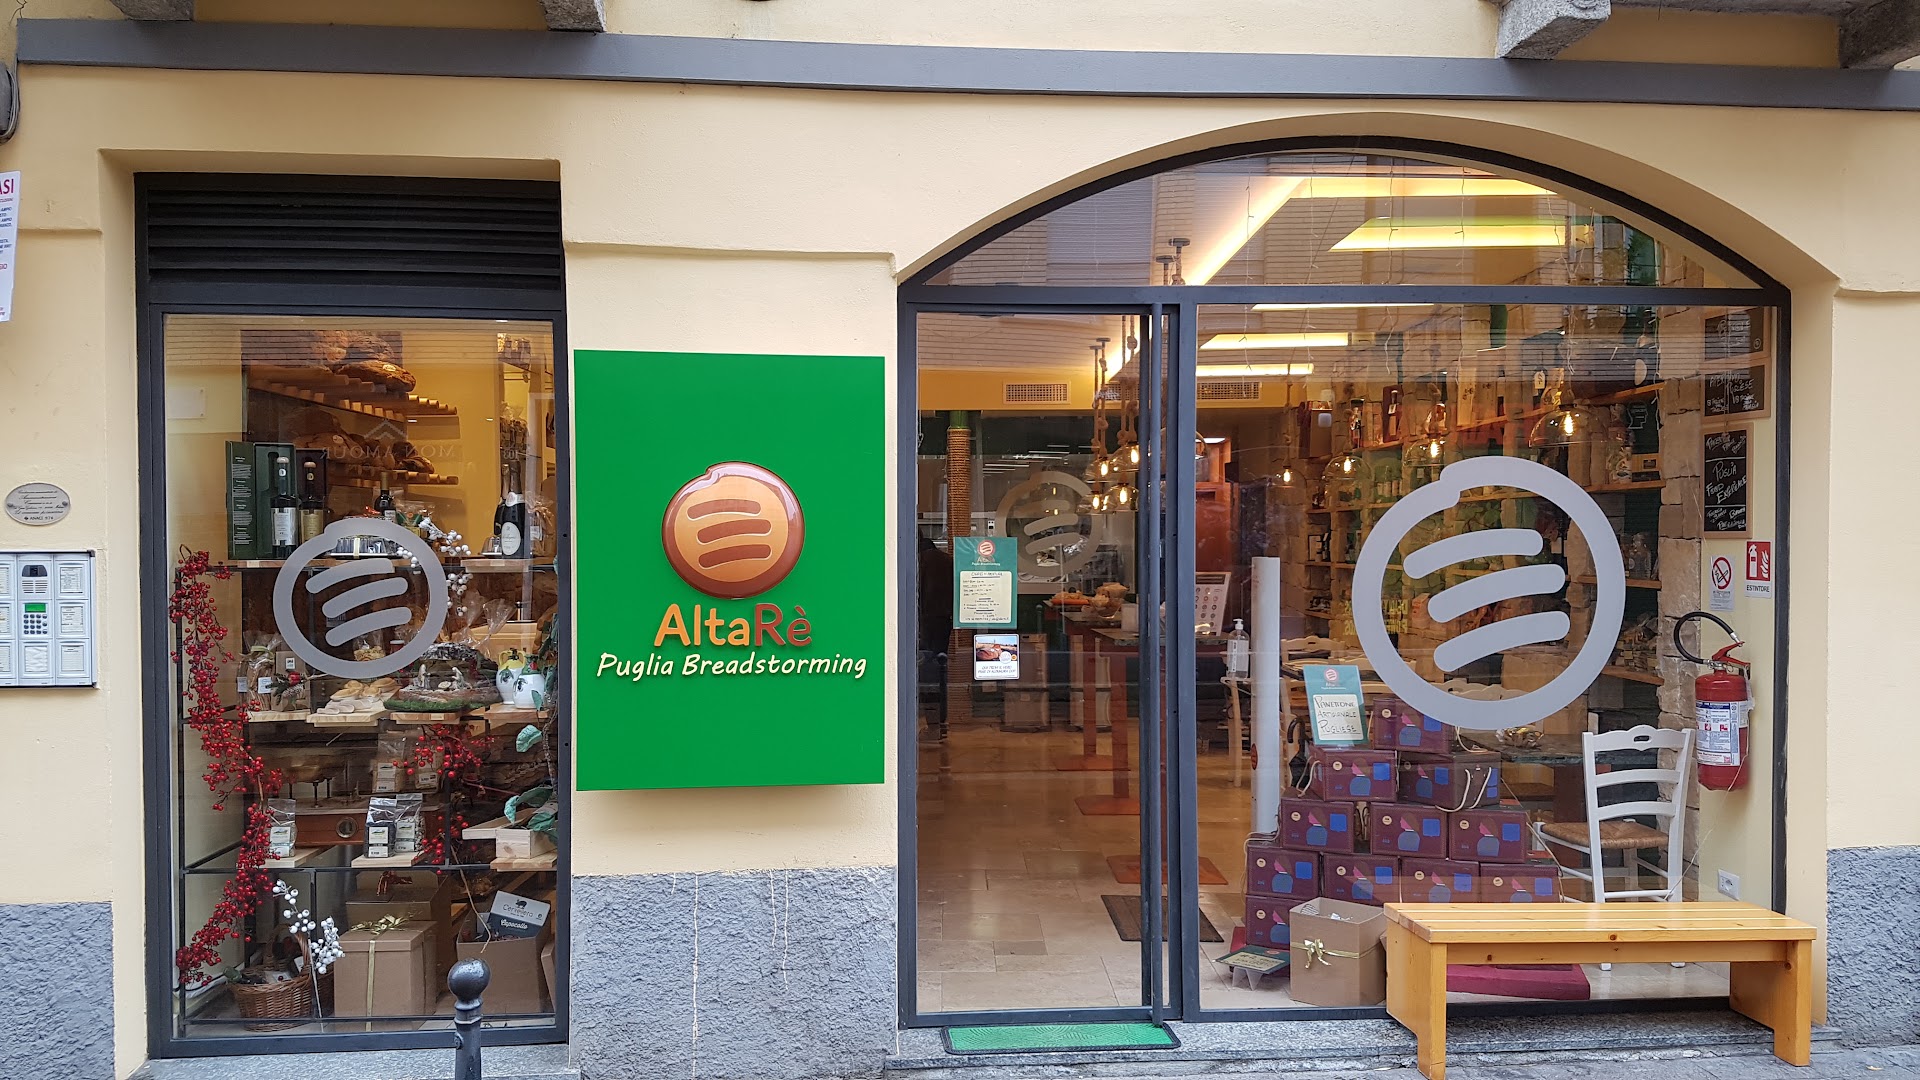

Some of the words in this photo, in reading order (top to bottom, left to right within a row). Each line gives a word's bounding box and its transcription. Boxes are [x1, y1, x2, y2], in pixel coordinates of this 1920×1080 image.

[1746, 584, 1770, 592] ESTINTORE
[653, 603, 812, 647] AltaRè
[596, 652, 674, 682] Puglia
[681, 651, 867, 679] Breadstorming
[1318, 719, 1357, 733] PUGLIESE
